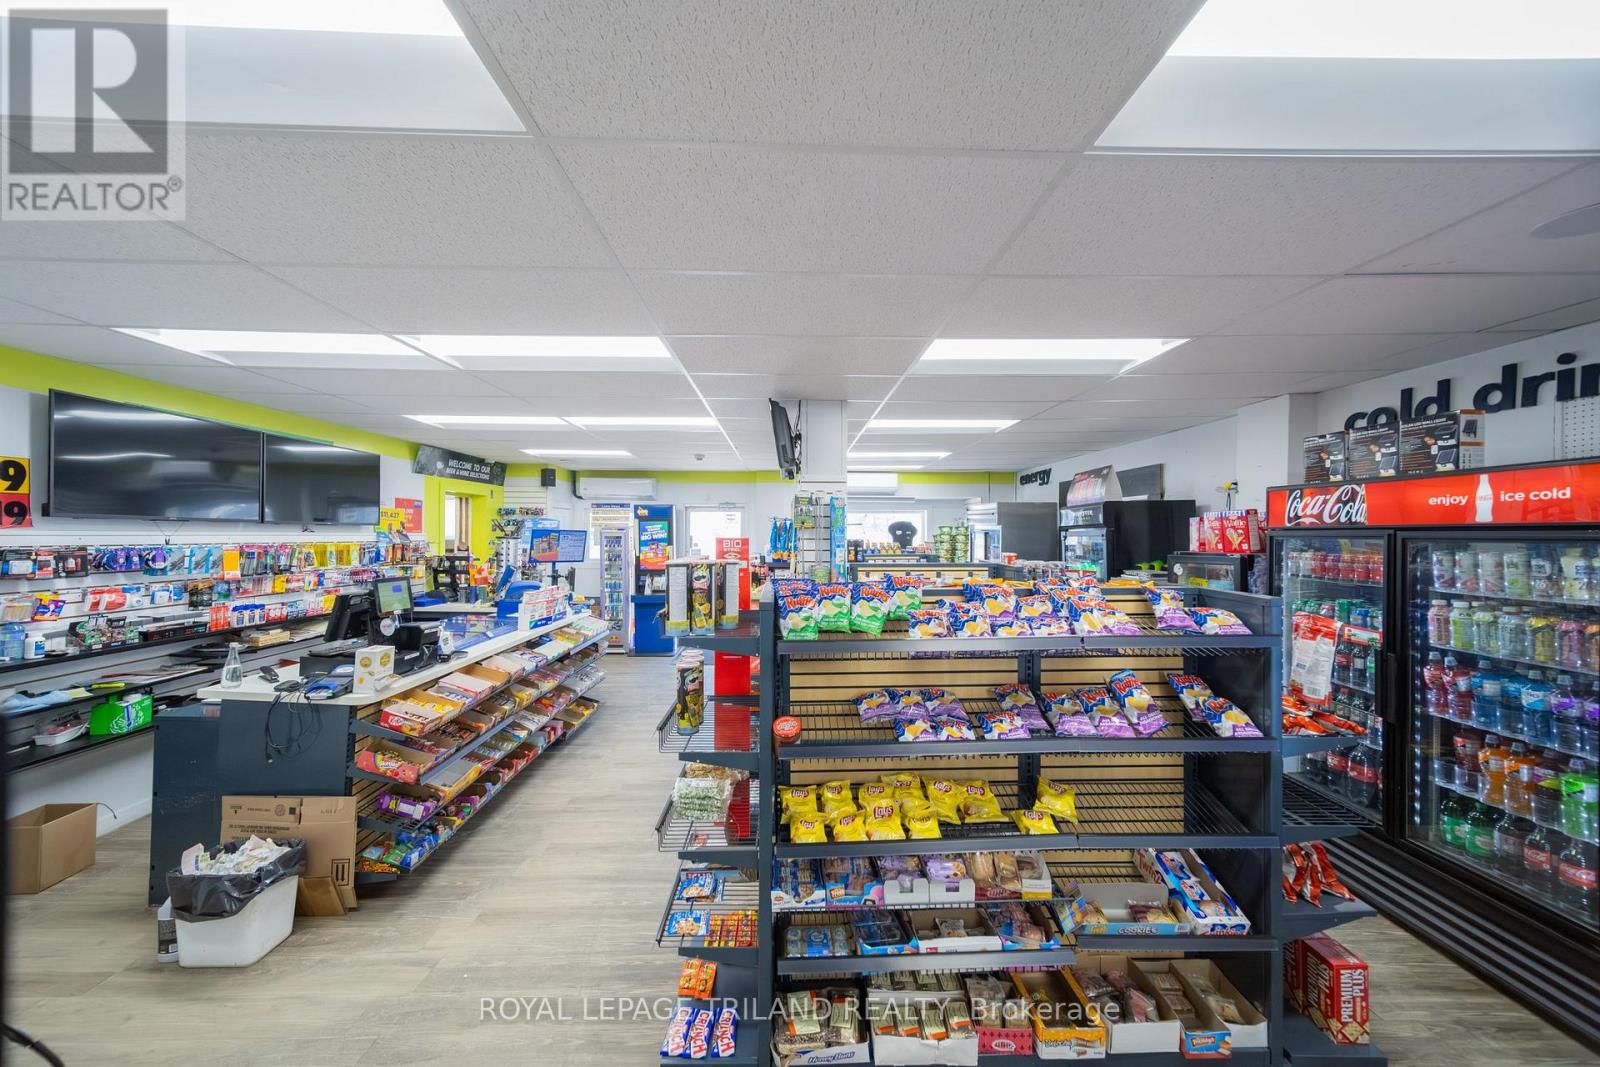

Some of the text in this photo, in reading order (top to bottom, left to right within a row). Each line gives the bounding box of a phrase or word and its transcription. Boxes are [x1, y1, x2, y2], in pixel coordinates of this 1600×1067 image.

[448, 458, 473, 470] WELCOME
[481, 465, 491, 474] OUR
[1020, 468, 1052, 486] energy
[1285, 484, 1368, 526] Coca-Cola
[1428, 487, 1571, 506] enjoy ice cold
[1340, 969, 1353, 1022] PREMIUM
[1353, 968, 1365, 997] PLUS
[692, 1010, 711, 1056] CRUNCH
[718, 1009, 736, 1055] CRUNCH
